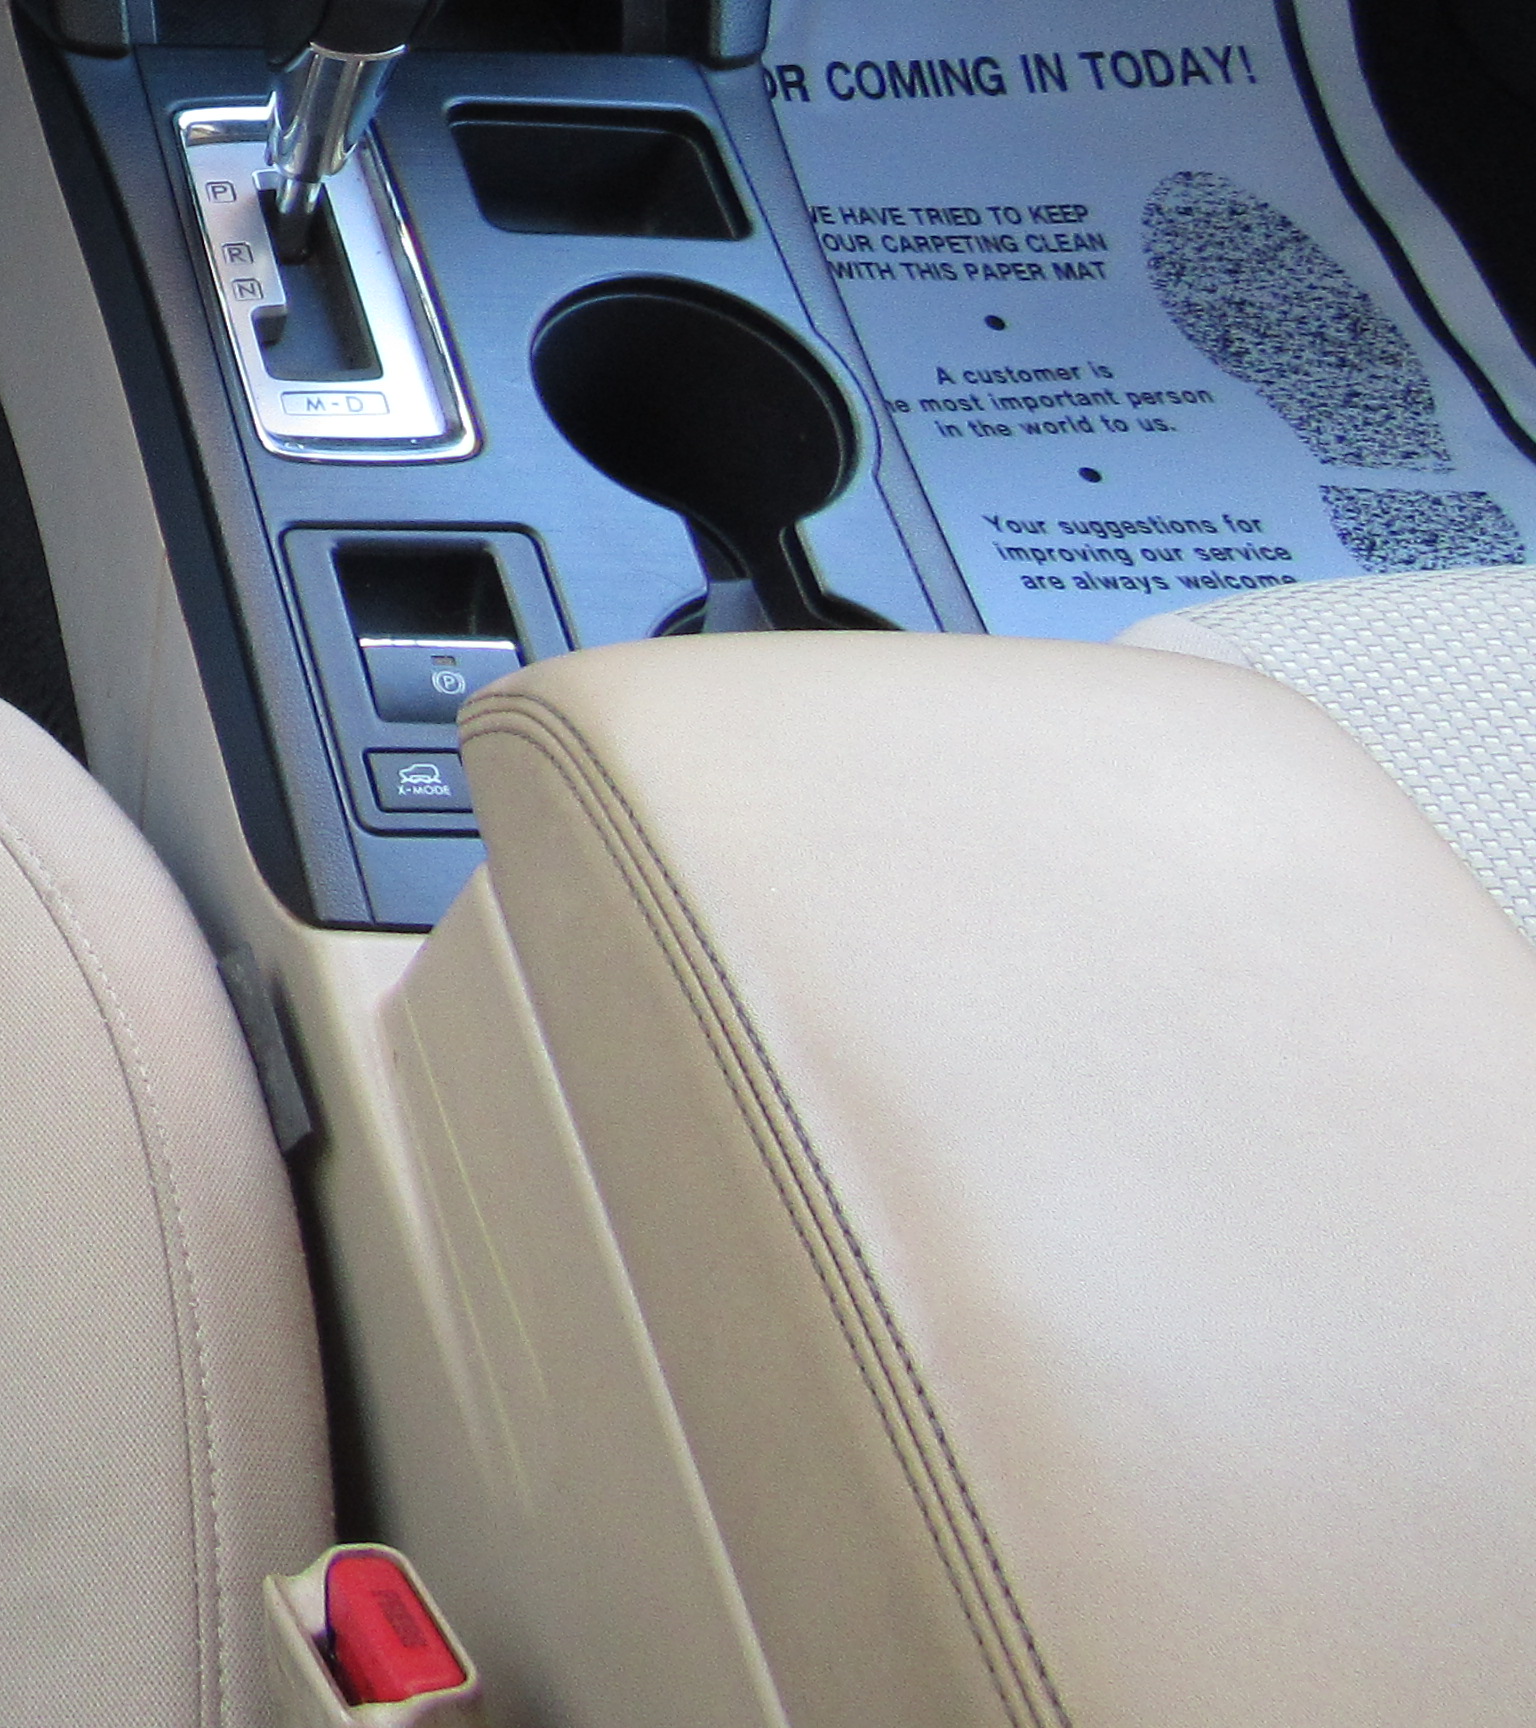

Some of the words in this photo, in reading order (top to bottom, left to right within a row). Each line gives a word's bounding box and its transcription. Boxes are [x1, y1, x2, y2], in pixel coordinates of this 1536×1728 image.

[826, 55, 1008, 101] COMING
[1019, 52, 1069, 94] IN
[1078, 44, 1258, 91] TODAY!
[839, 206, 907, 226] HAVE
[908, 206, 982, 227] TRIED
[986, 205, 1022, 225] TO
[1028, 203, 1090, 225] KEEP
[822, 232, 875, 254] OUR
[880, 232, 1019, 254] CARPETING
[1026, 232, 1108, 253] CLEAN
[828, 260, 896, 282] WITH
[898, 261, 959, 282] THIS
[963, 262, 1046, 282] PAPER
[1052, 260, 1108, 282] MAT
[935, 366, 956, 385] A
[962, 364, 1081, 385] customer
[1089, 361, 1114, 380] is
[885, 398, 911, 413] he
[919, 394, 985, 414] most
[988, 388, 1121, 416] important
[1125, 387, 1216, 410] person
[934, 420, 963, 438] in
[966, 419, 1013, 439] the
[1017, 415, 1095, 437] world
[1099, 414, 1129, 433] to
[1136, 415, 1177, 433] us.
[981, 514, 1048, 535] Your
[1057, 515, 1219, 539] suggestions
[1221, 513, 1264, 534] for
[991, 540, 1135, 566] improving
[1140, 546, 1184, 563] our
[1192, 541, 1293, 562] service
[1020, 573, 1066, 590] are
[1072, 570, 1171, 595] always
[397, 786, 452, 796] X-MODE
